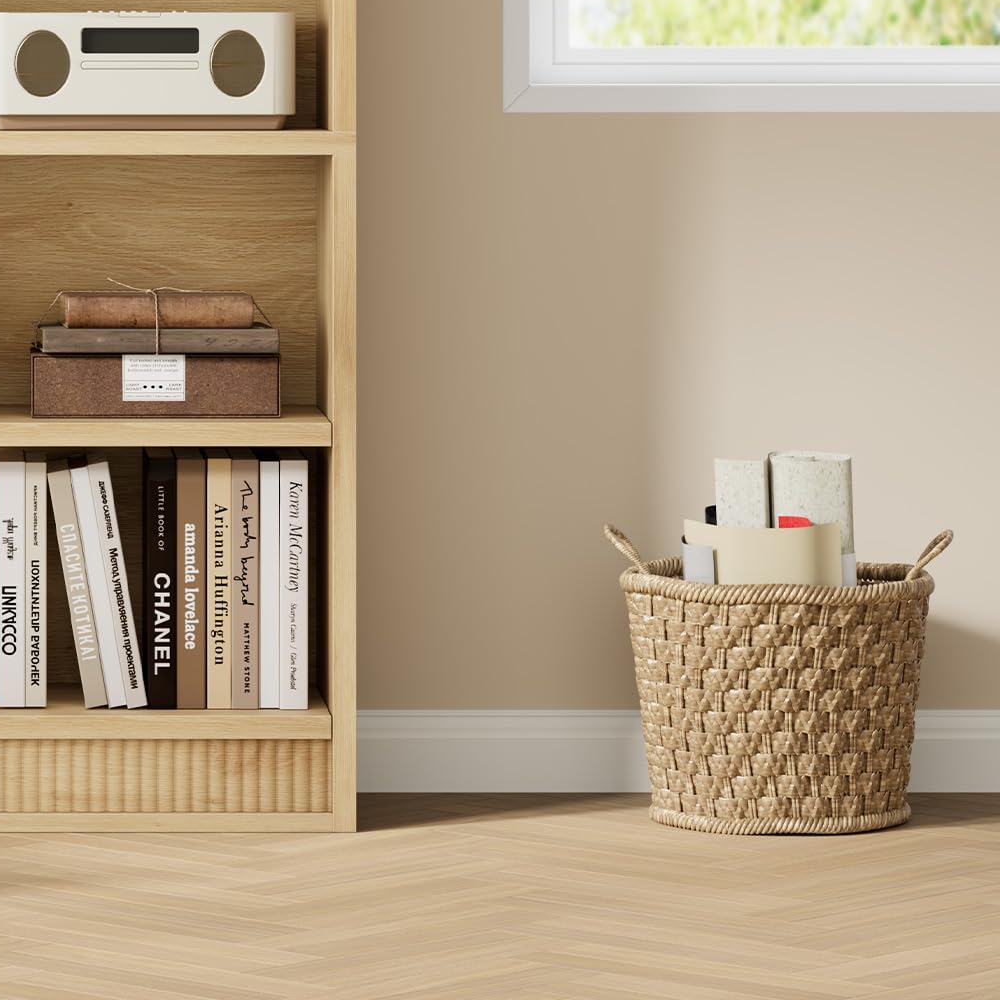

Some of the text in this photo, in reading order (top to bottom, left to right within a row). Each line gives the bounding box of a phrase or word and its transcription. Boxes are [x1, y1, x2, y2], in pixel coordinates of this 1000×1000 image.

[99, 481, 114, 539] ДЖЕФФ САЗЕРЛЕНД
[158, 540, 164, 551] OF
[234, 480, 256, 606] The body beyond
[285, 481, 302, 593] Karen McCartney
[60, 524, 96, 662] СПАСИТЕ КОТИКА!
[109, 548, 121, 578] Метод
[122, 639, 138, 689] проектами
[154, 573, 171, 675] CHANEL
[184, 523, 199, 649] amanda lovelace
[212, 504, 228, 665] Arianna Huffington
